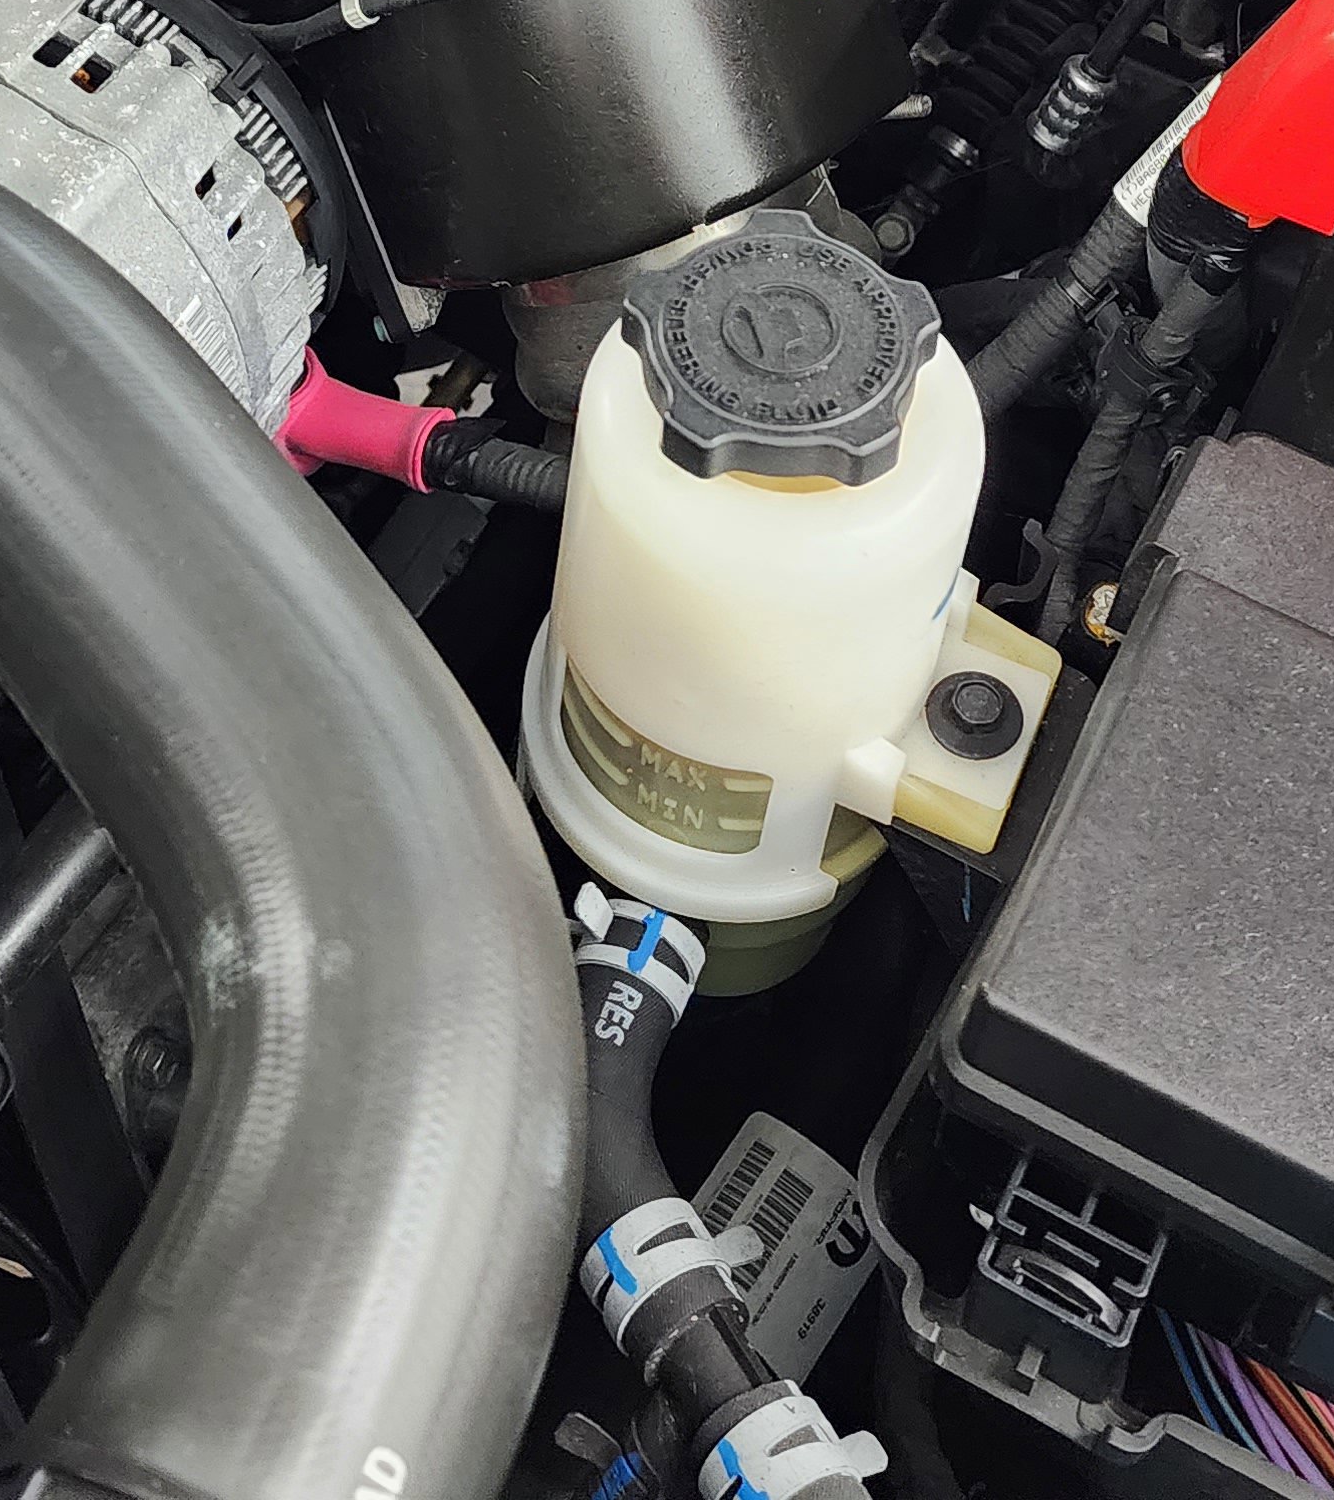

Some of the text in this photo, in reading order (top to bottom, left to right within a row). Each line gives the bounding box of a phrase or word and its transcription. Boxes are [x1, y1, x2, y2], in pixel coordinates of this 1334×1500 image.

[796, 242, 899, 396] USE APPROVED
[640, 742, 708, 792] MAX
[637, 782, 704, 830] MIN
[594, 980, 644, 1047] RES
